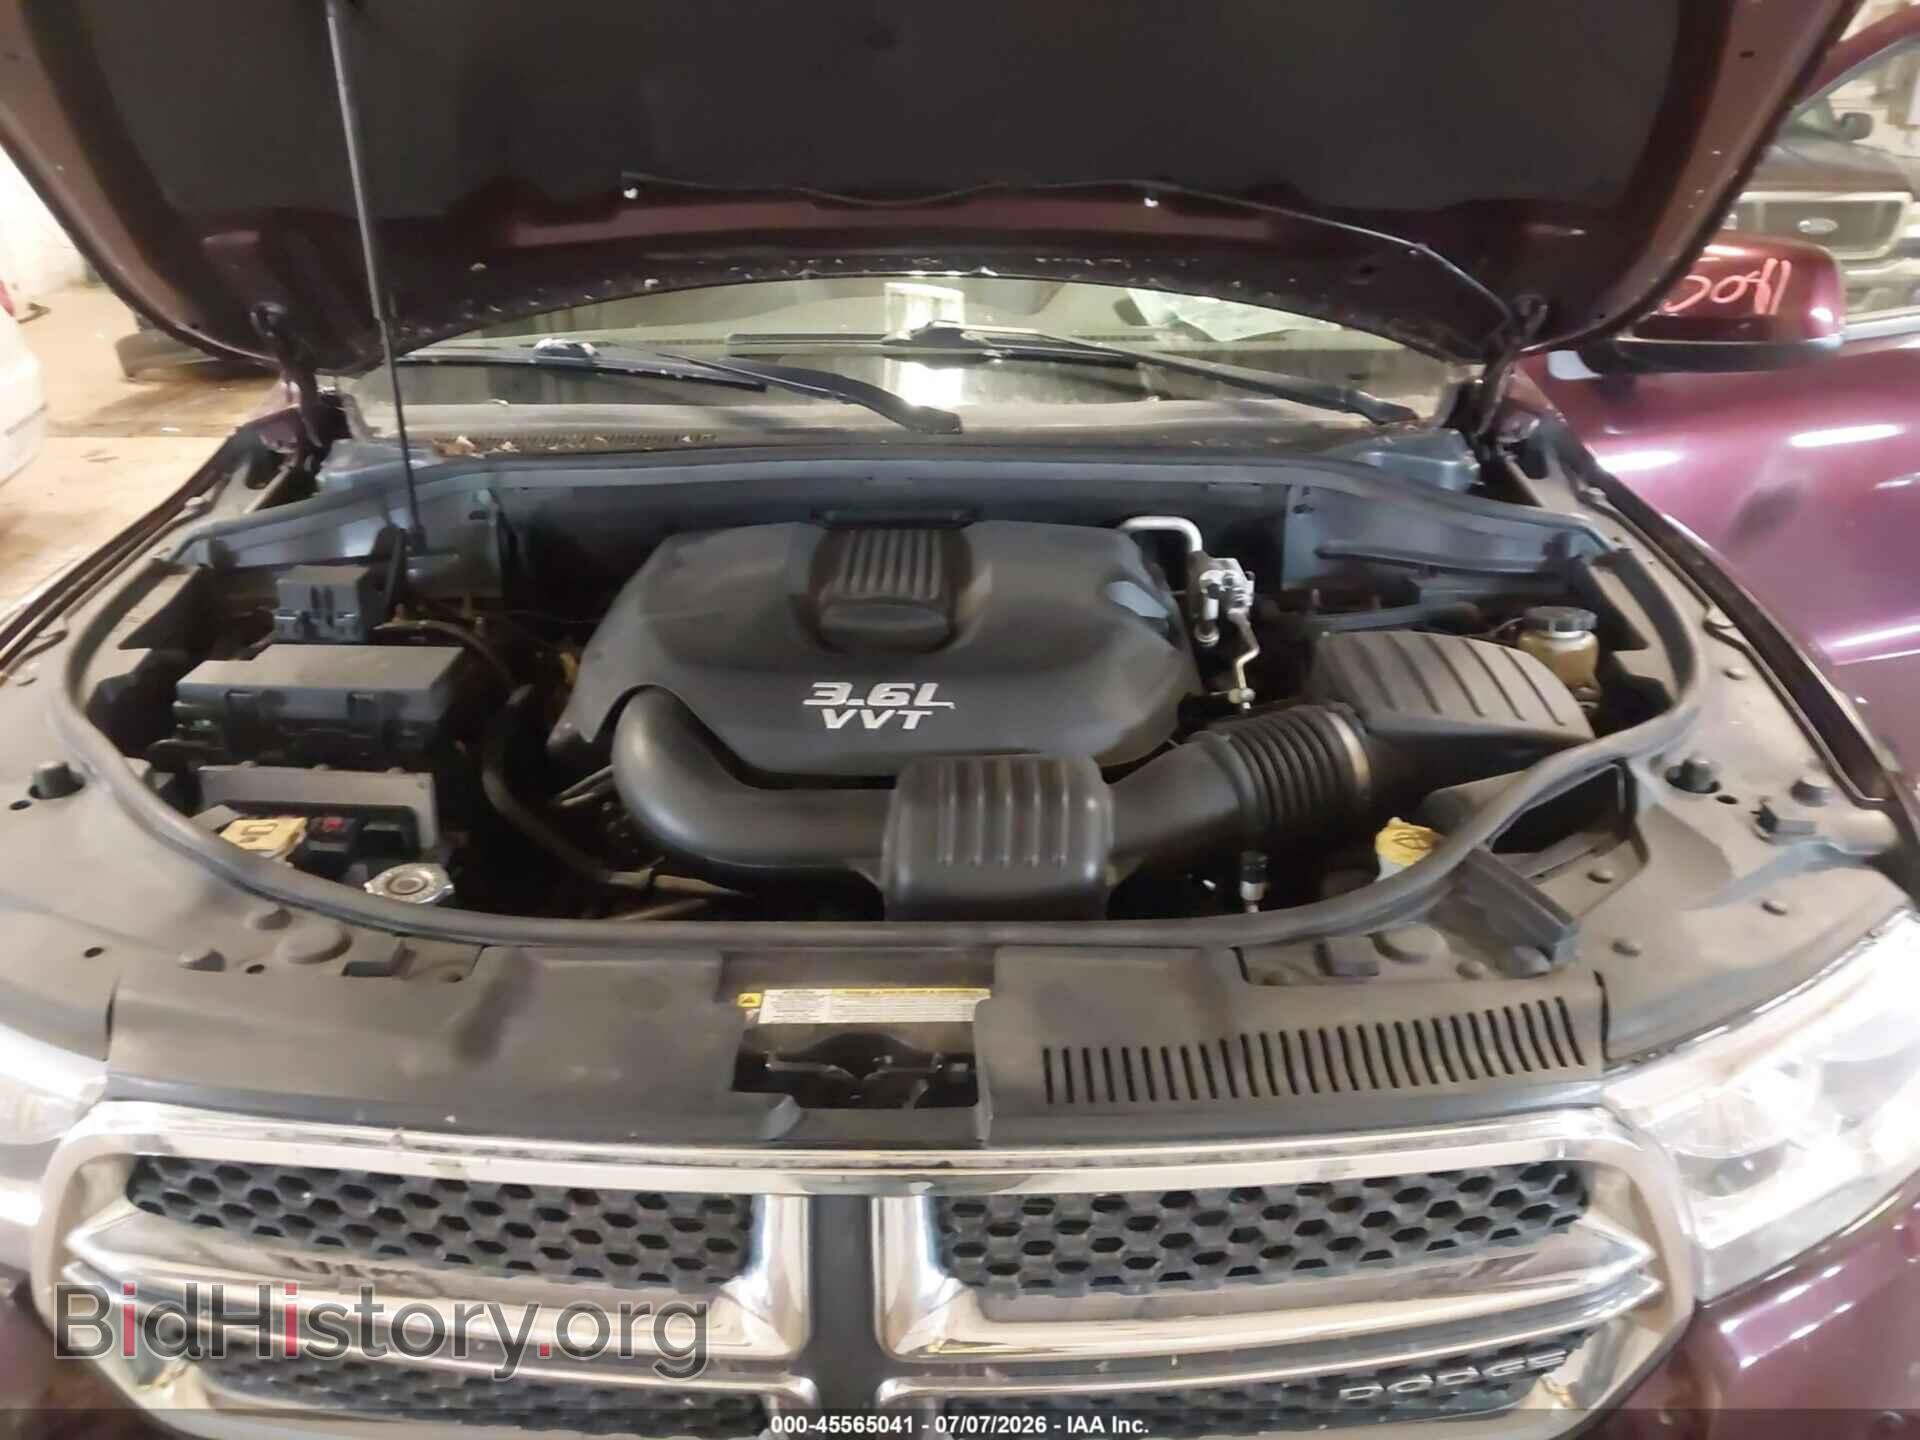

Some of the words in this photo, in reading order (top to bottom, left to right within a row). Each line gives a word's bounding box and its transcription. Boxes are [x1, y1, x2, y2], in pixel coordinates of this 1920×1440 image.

[802, 682, 955, 709] 3.6L
[821, 708, 933, 729] VVT
[1338, 1349, 1568, 1401] DODGE
